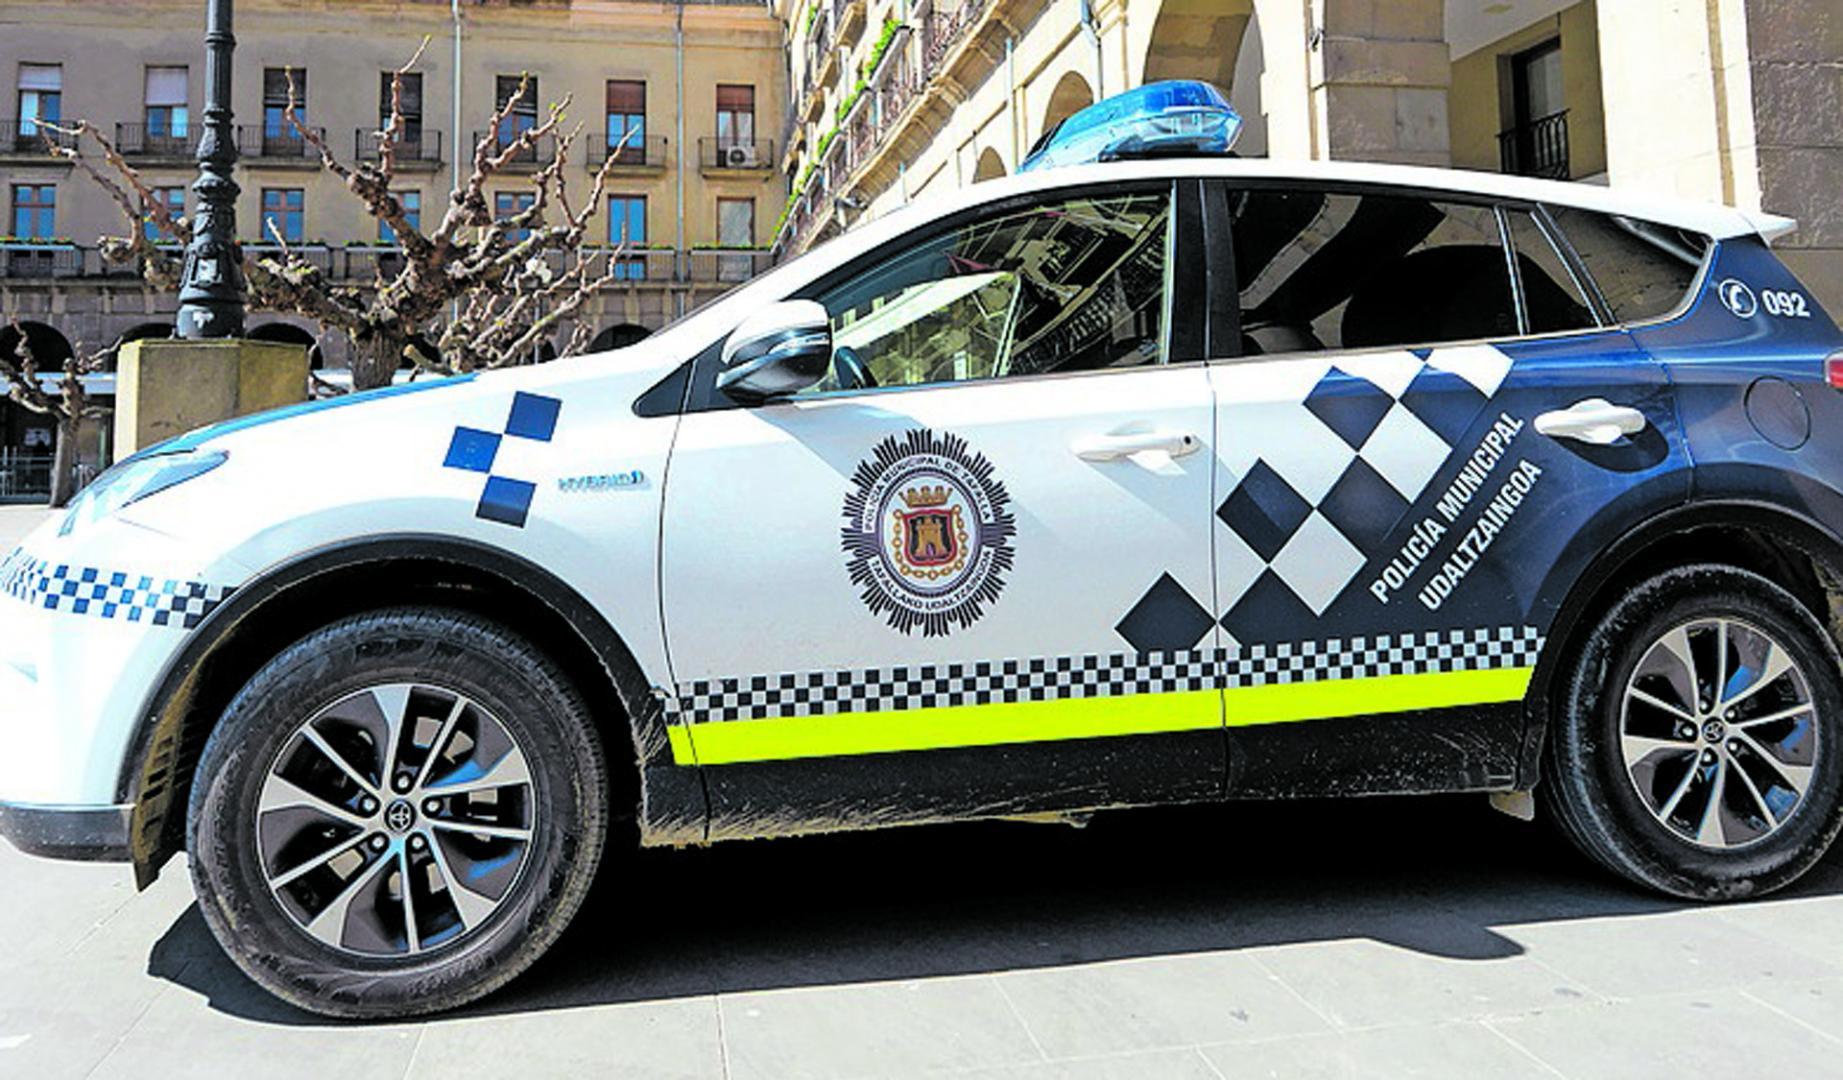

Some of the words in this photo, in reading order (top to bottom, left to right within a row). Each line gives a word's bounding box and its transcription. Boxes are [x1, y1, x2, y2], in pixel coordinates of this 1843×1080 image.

[1761, 289, 1811, 317] 092
[558, 473, 630, 491] HYBRID
[882, 456, 942, 483] MUNICIPAL
[944, 461, 961, 474] DE
[1369, 517, 1448, 604] POLICÍA
[1435, 412, 1526, 522] MUNICIPAL
[1418, 459, 1542, 610] UDALTZAINGOA
